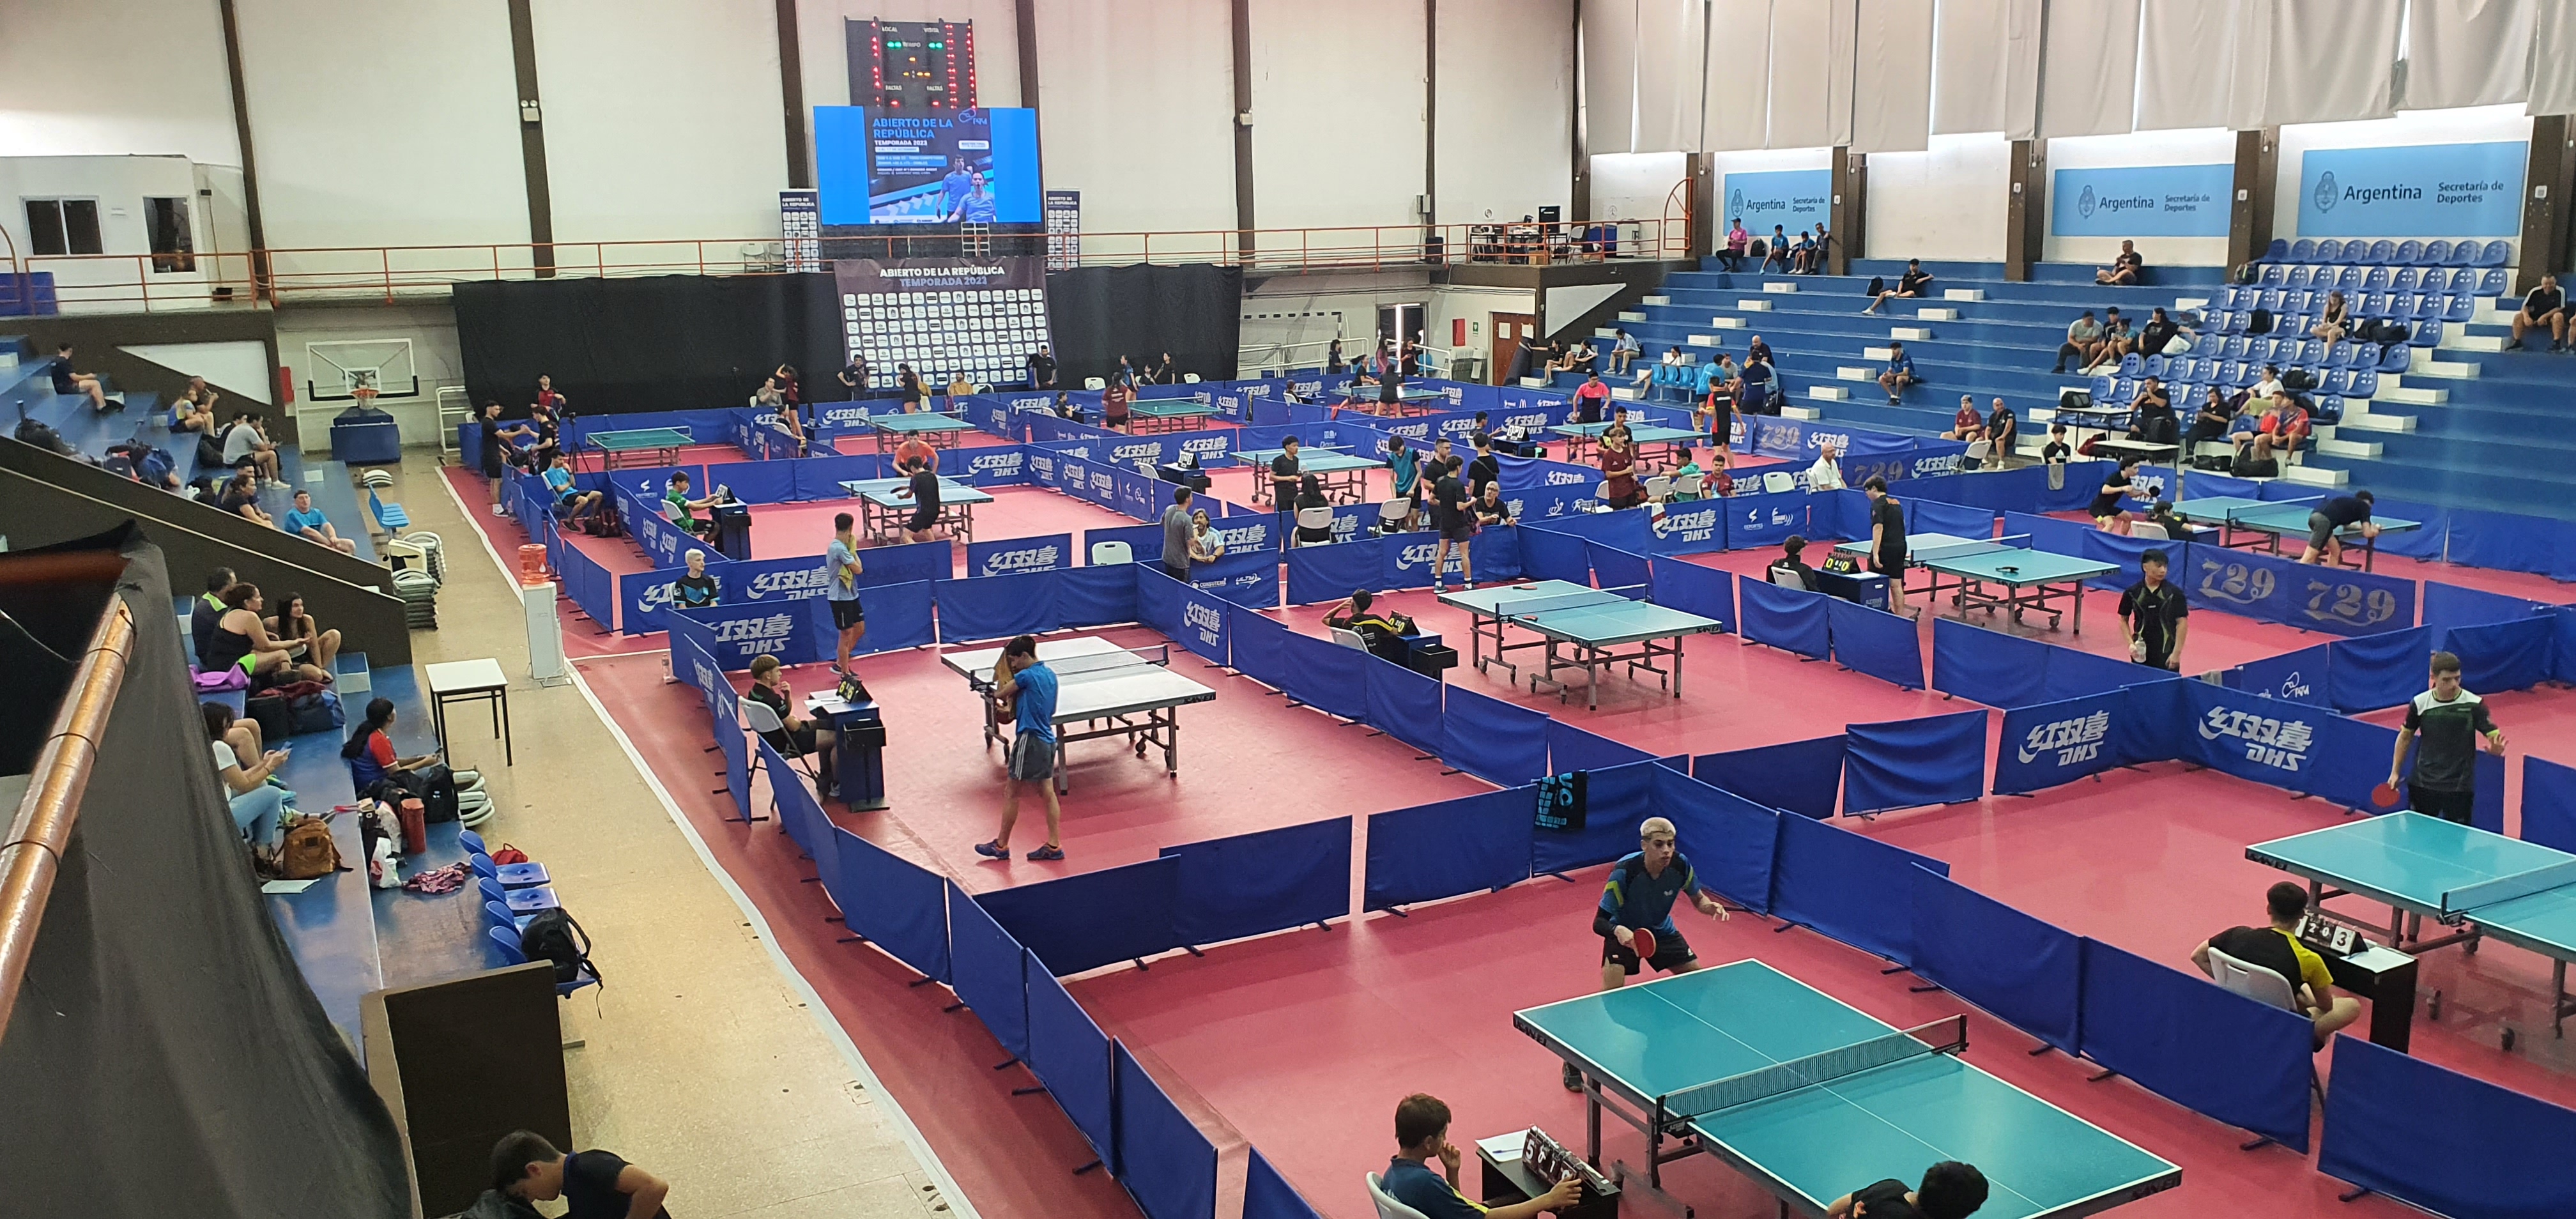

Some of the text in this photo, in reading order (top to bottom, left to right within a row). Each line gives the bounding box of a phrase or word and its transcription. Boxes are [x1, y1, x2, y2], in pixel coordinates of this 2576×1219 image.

[873, 118, 953, 128] ABIERTO DE LA
[873, 128, 935, 139] REPÚBLICA
[2344, 184, 2422, 205] Argentina
[2438, 180, 2504, 192] Secretaría de
[1746, 199, 1786, 213] Argentina
[2099, 195, 2154, 212] Argentina
[2165, 194, 2200, 203] Secretaría
[2165, 204, 2196, 212] Deportes
[2437, 193, 2483, 205] Deportes
[880, 264, 1005, 277] ABIERTO DE LA REPÚBLICA
[900, 277, 963, 287] TEMPORADA
[843, 419, 866, 427] DHS
[1183, 436, 1228, 452] 红双喜
[1761, 424, 1800, 450] 729
[1110, 441, 1162, 463] 红双喜
[1200, 450, 1226, 459] DHS
[969, 452, 1023, 474] 红双喜
[992, 466, 1022, 477] DHS
[1656, 509, 1716, 539] 红双喜
[1221, 524, 1266, 546] 双喜
[1681, 528, 1714, 542] DHS
[983, 545, 1058, 576] 红双喜
[1825, 558, 1850, 571] 0 0
[746, 565, 830, 599] 红双喜
[2198, 558, 2275, 604] 729
[2303, 578, 2395, 626] 729
[1184, 601, 1220, 632] 红双喜
[737, 638, 791, 655] DHS
[1199, 627, 1220, 647] DHS
[2018, 710, 2110, 763] 红双喜
[2198, 706, 2313, 752] 红双喜
[2058, 740, 2104, 767] DHS
[2245, 742, 2307, 771] DHS
[2308, 923, 2319, 933] 2
[2336, 931, 2347, 947] 3
[1526, 1138, 1535, 1160] 5
